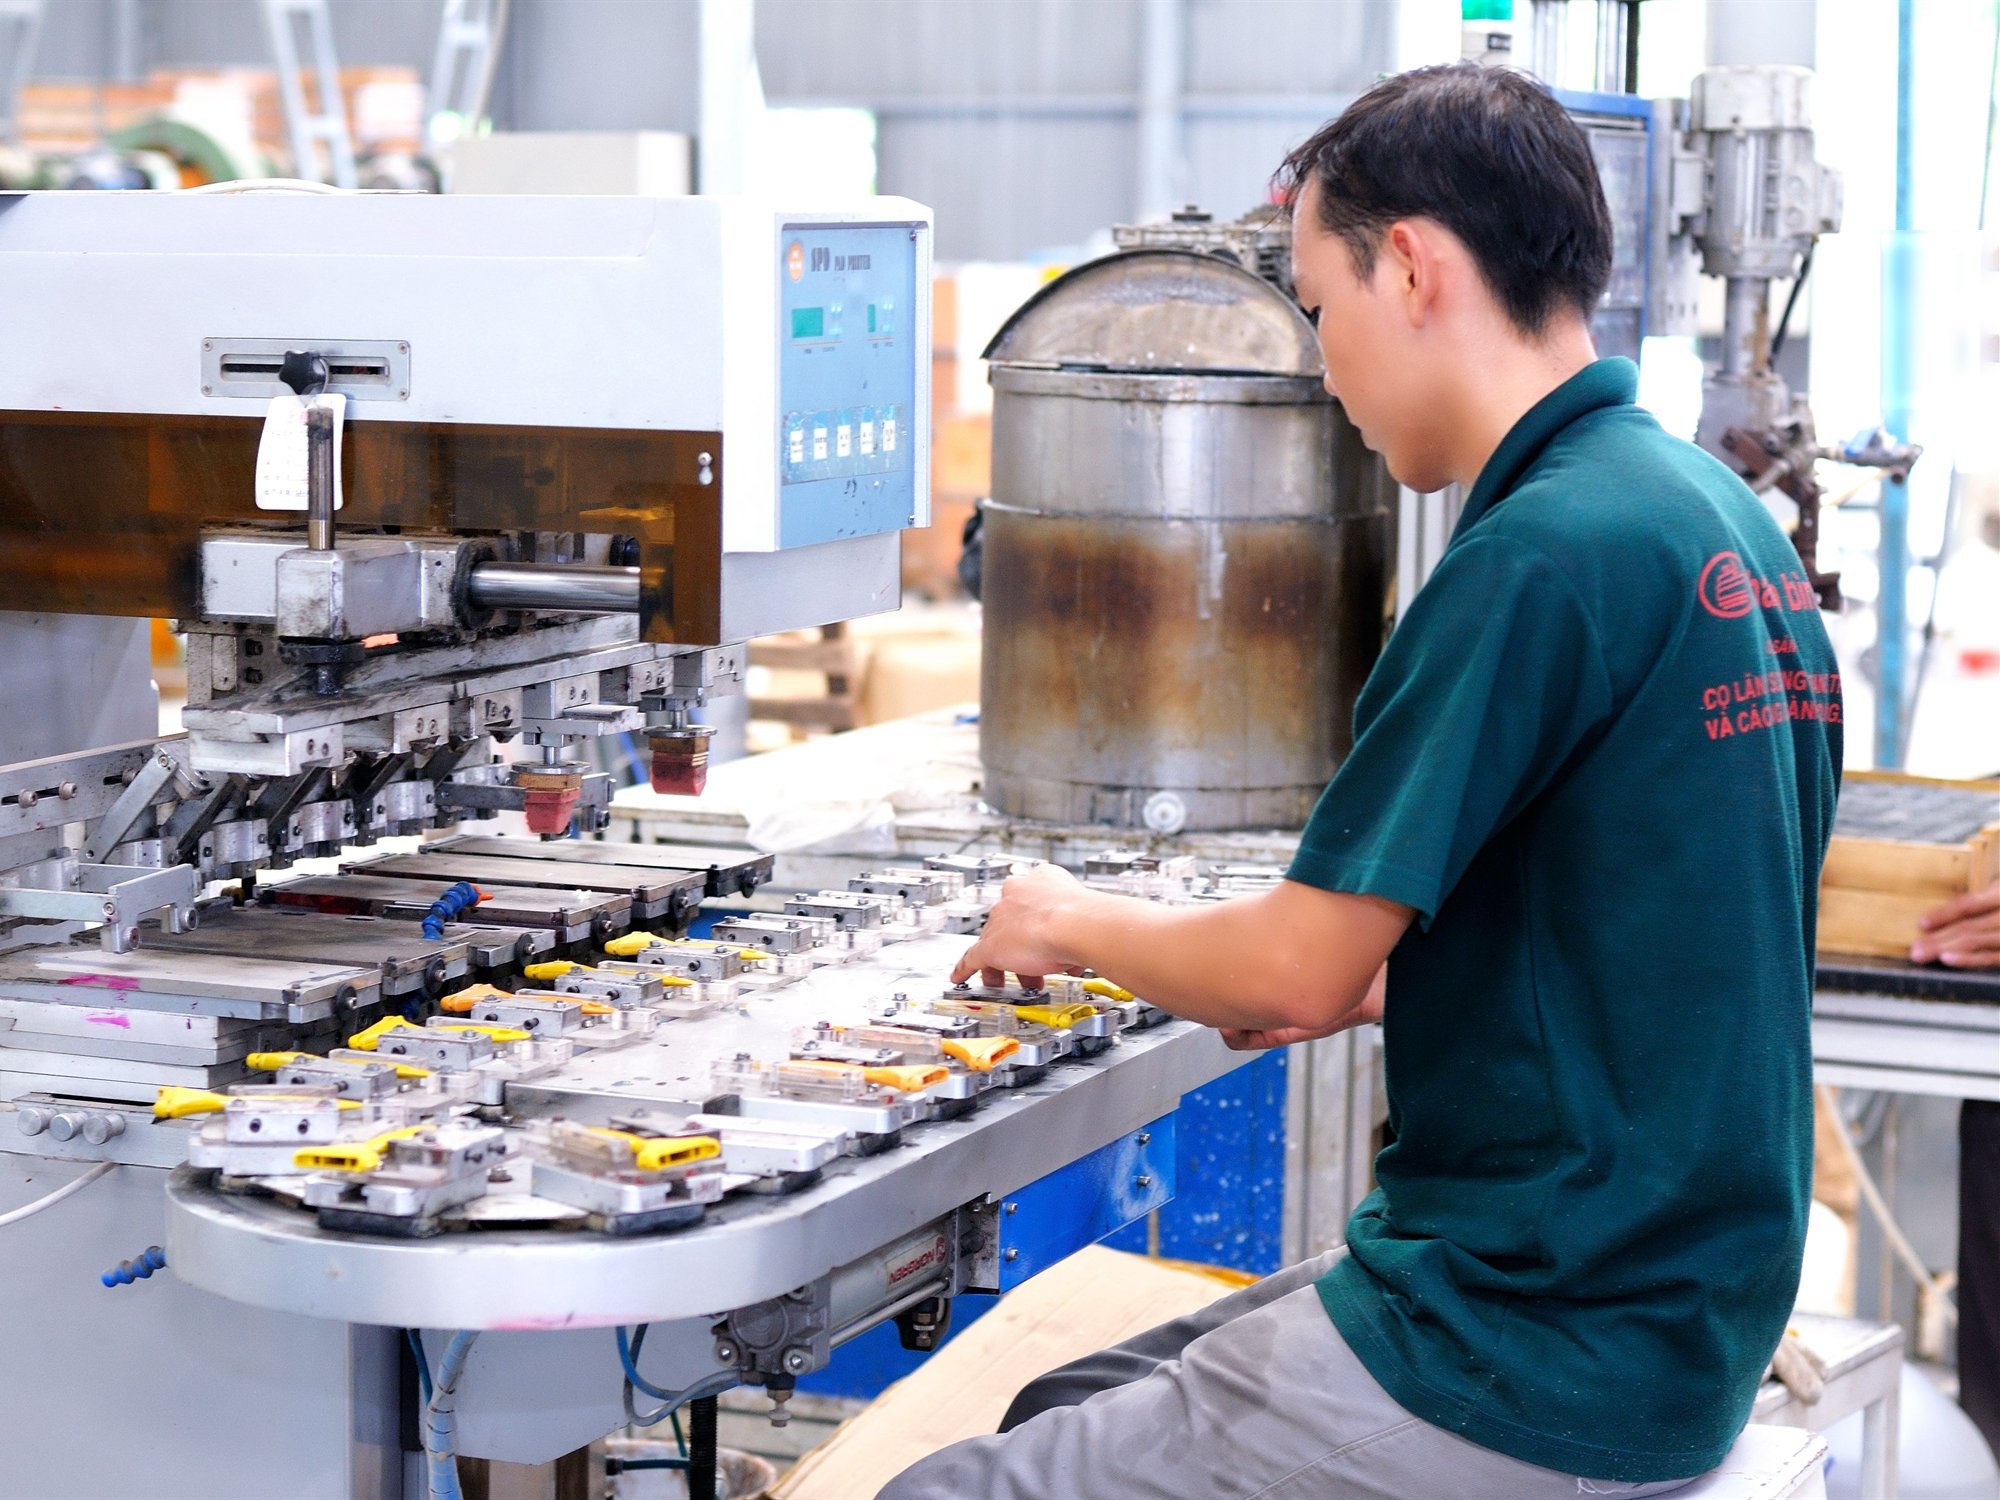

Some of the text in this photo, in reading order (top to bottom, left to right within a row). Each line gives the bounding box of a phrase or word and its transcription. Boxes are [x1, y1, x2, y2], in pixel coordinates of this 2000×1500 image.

[1702, 684, 1731, 711] CỌ
[1705, 711, 1734, 740] VÀ
[889, 1248, 935, 1285] NORGREN
